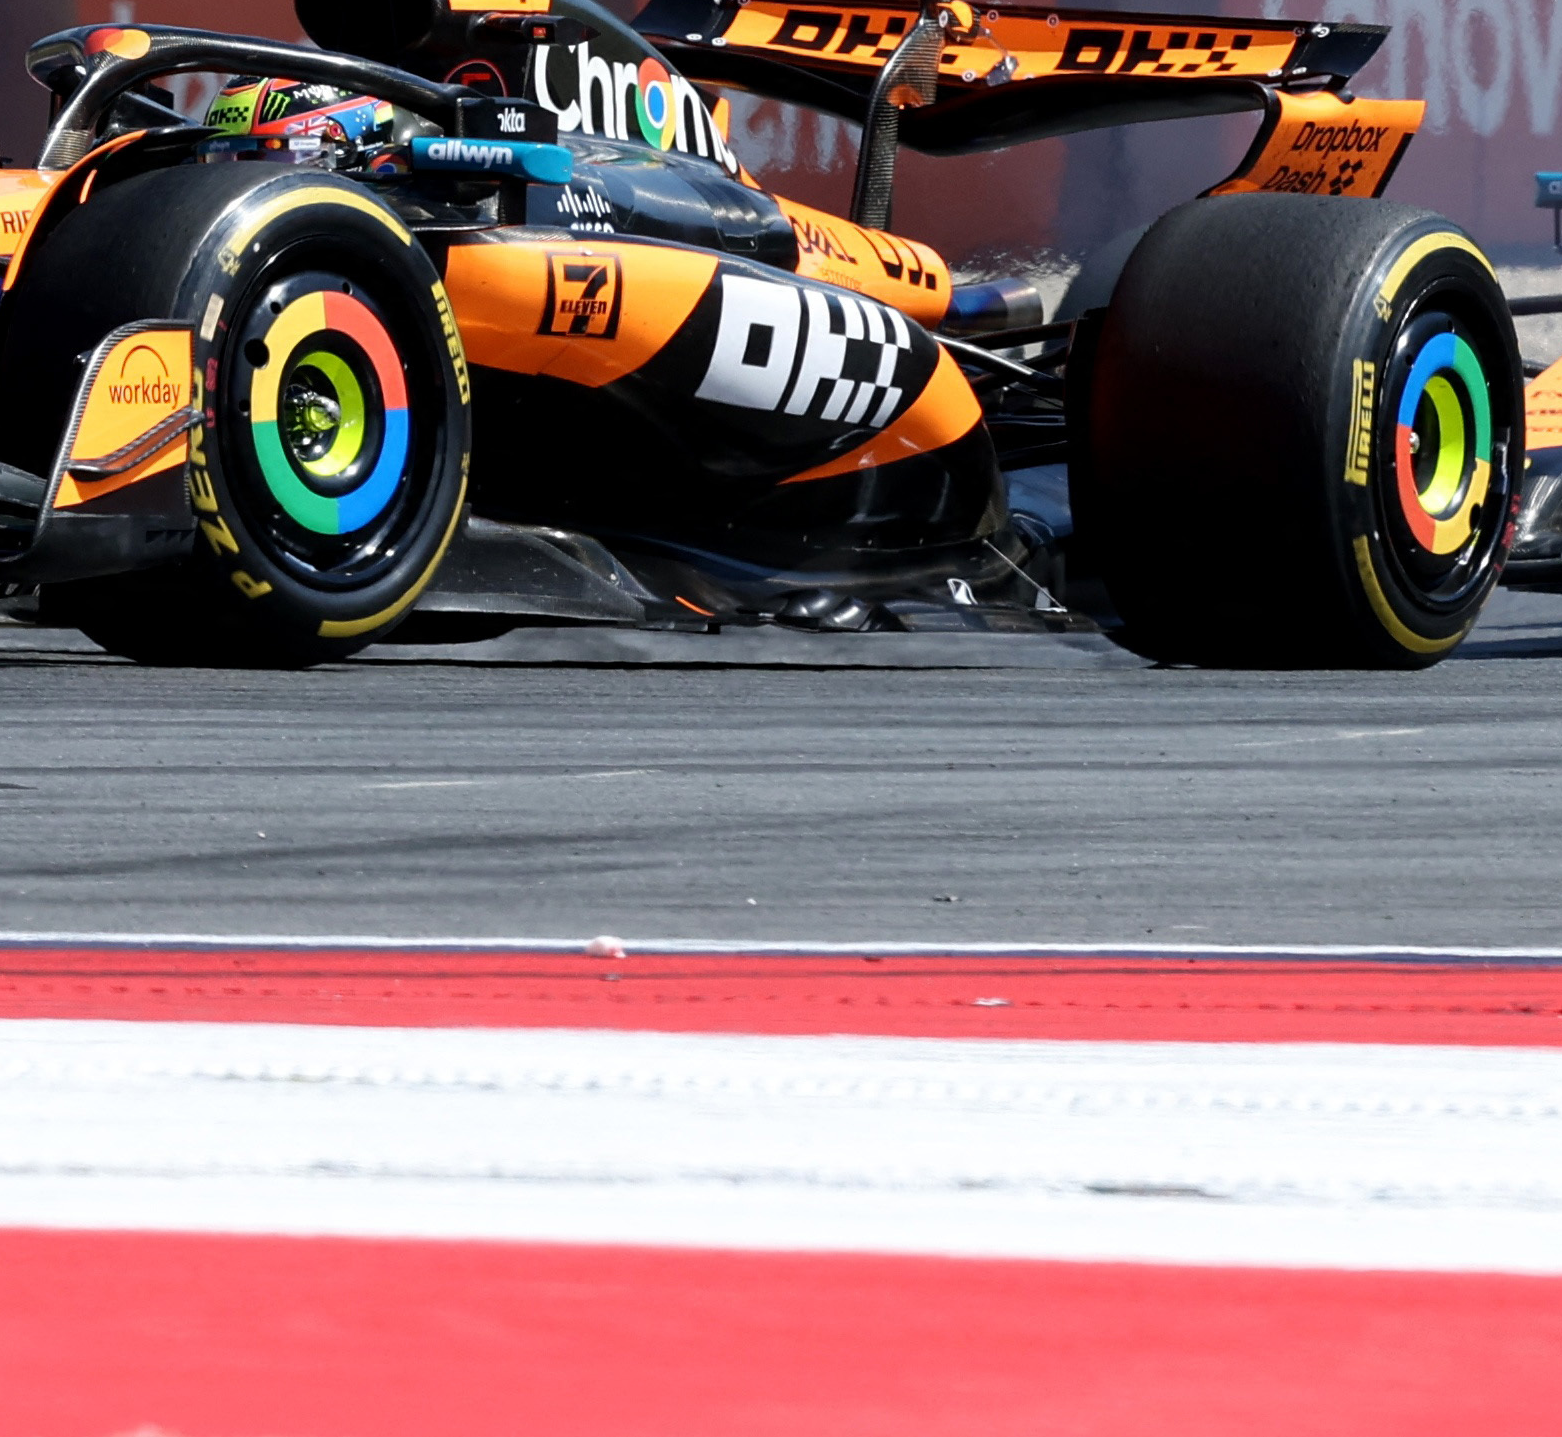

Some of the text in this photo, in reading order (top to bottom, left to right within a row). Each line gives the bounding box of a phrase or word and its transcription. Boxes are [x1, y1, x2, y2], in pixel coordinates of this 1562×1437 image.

[768, 9, 959, 66] OK
[1056, 28, 1254, 74] OKX
[427, 140, 514, 169] allwyn
[1291, 120, 1389, 154] Dropbox
[1264, 164, 1326, 195] Dash
[695, 274, 912, 429] OKX
[109, 379, 182, 410] workday
[1344, 357, 1376, 487] PIRELLI
